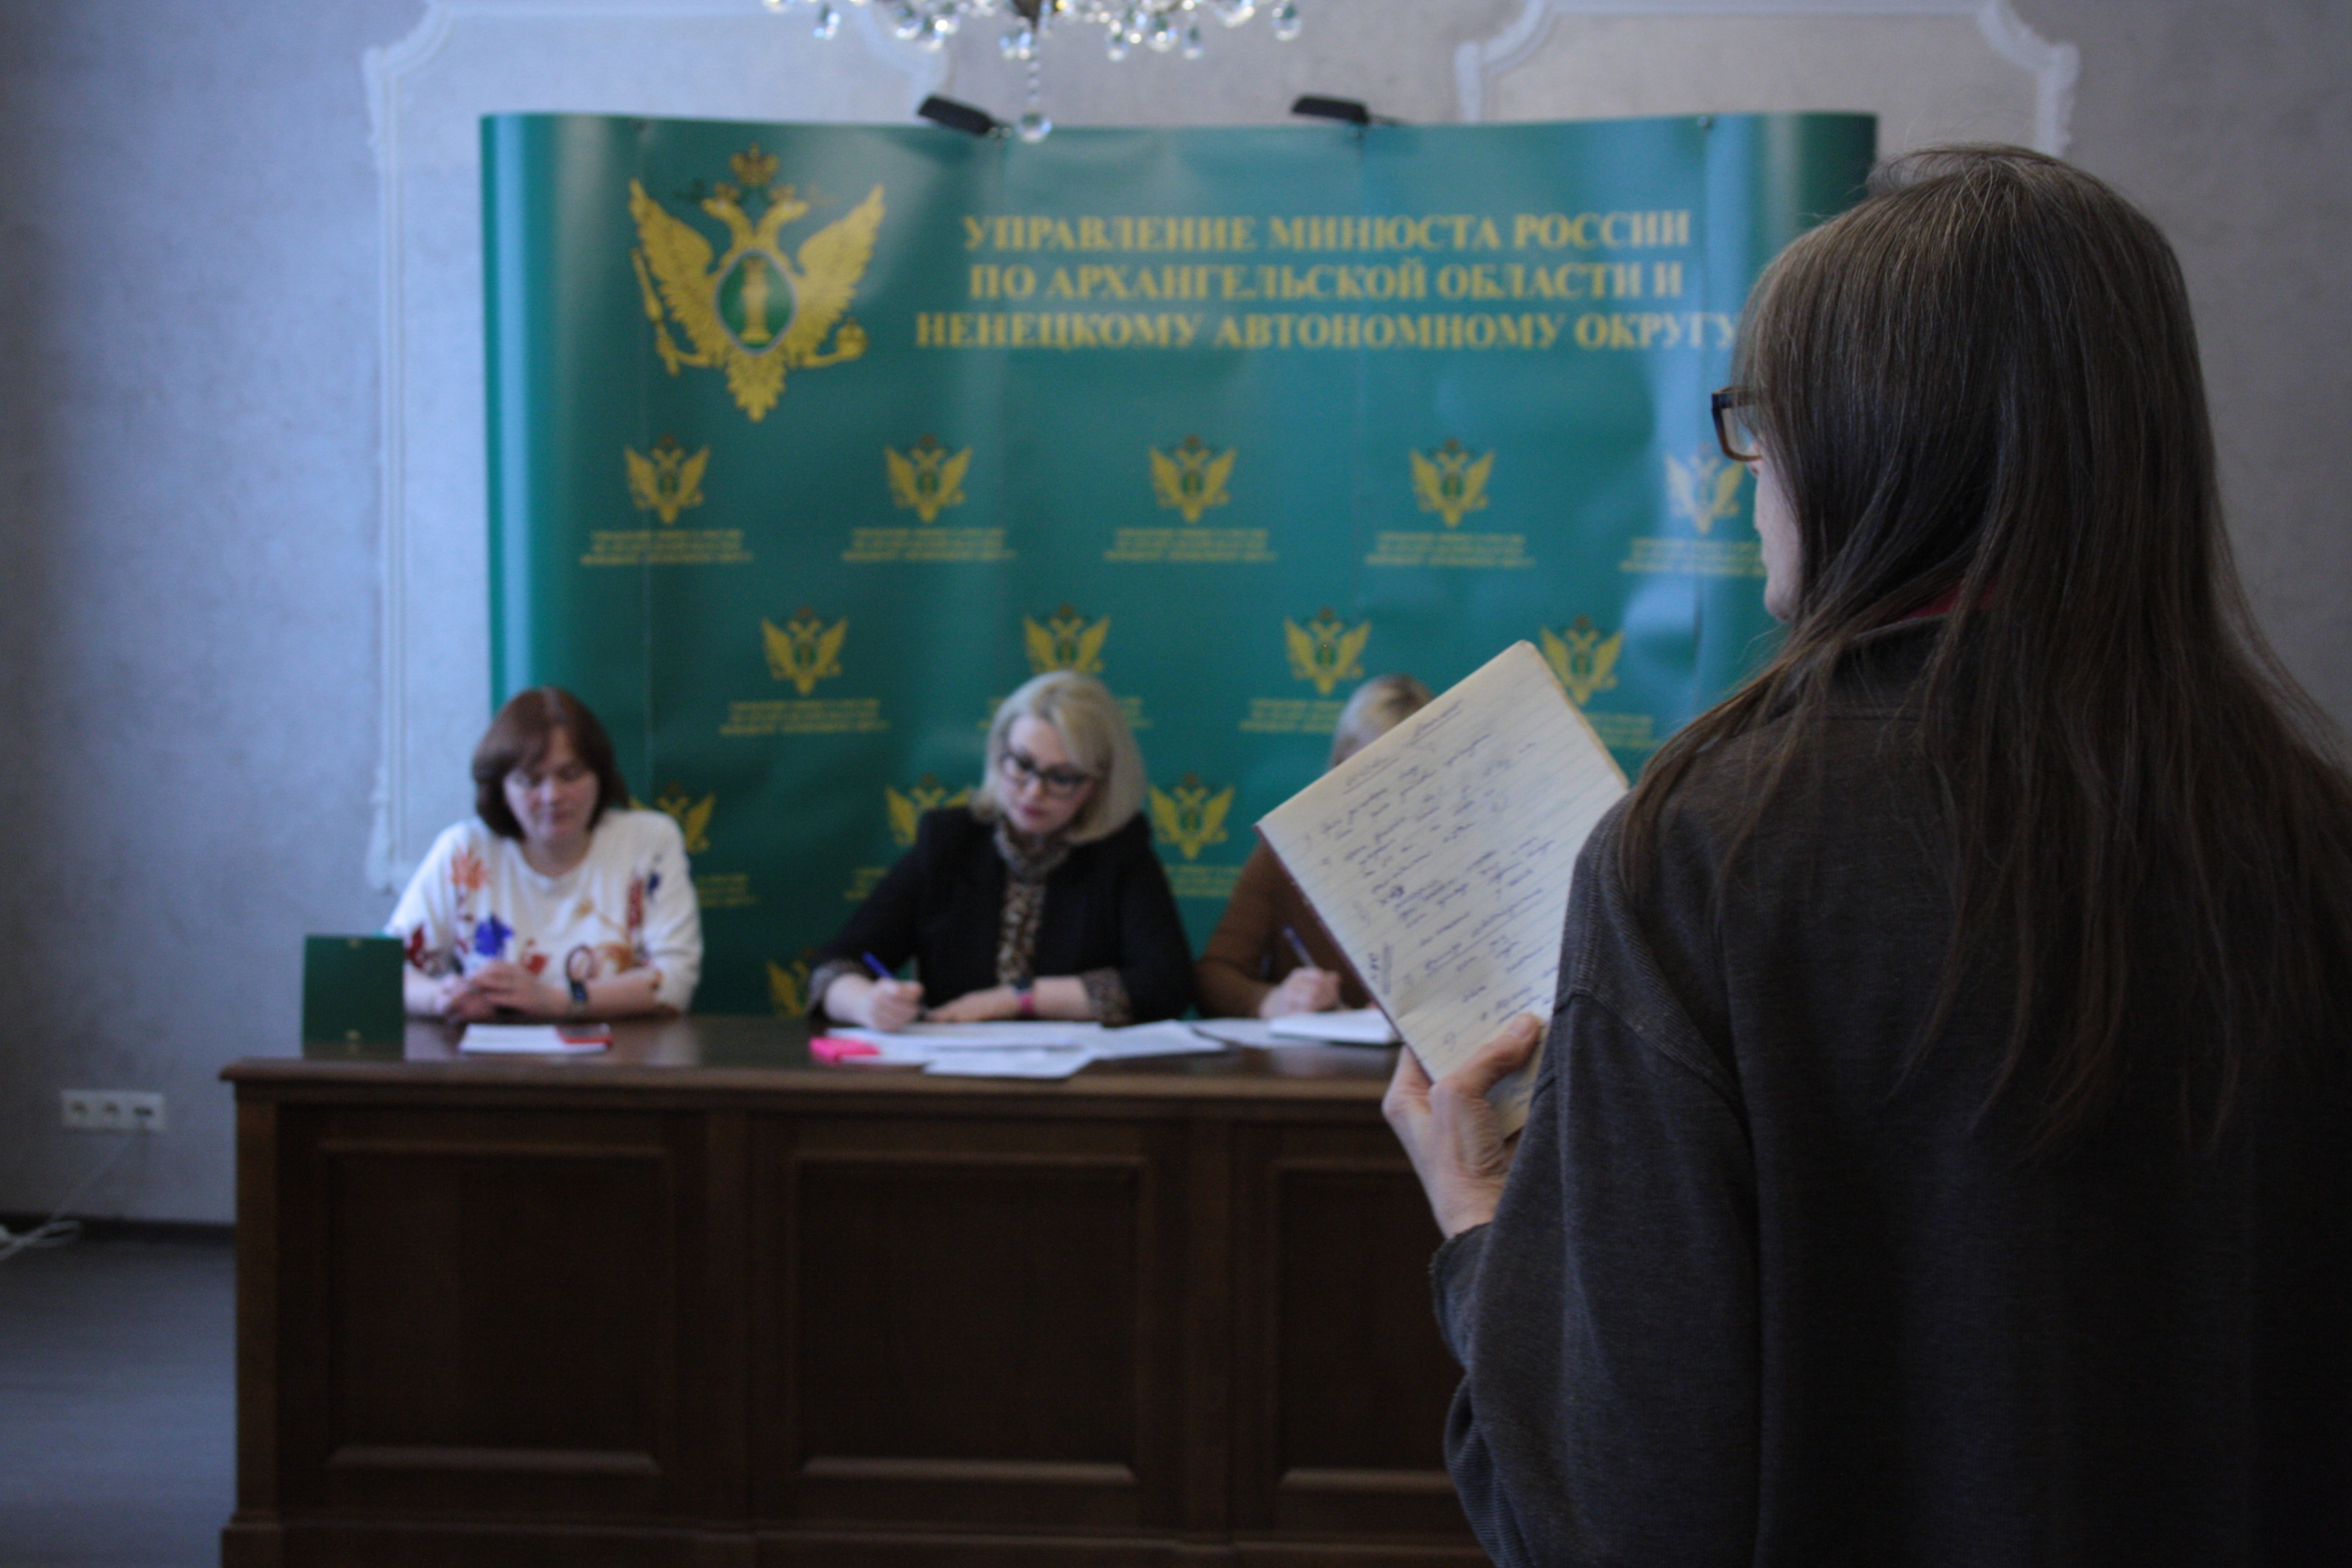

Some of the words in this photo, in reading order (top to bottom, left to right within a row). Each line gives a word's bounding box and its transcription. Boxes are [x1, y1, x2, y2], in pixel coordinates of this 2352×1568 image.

[963, 215, 1256, 252] УПРАВЛЕНИЕ
[1269, 214, 1502, 252] МИНЮСТА
[1514, 210, 1690, 249] РОССИИ
[971, 263, 1036, 299] ПО
[1044, 256, 1427, 300] АРХАНГЕЛЬСКОЙ
[1436, 263, 1641, 300] ОБЛАСТИ
[1653, 261, 1683, 298] И
[916, 312, 1205, 350] НЕНЕЦКОМУ
[1212, 313, 1566, 350] АВТОНОМНОМУ
[1575, 312, 1736, 349] ОКРУГУ
